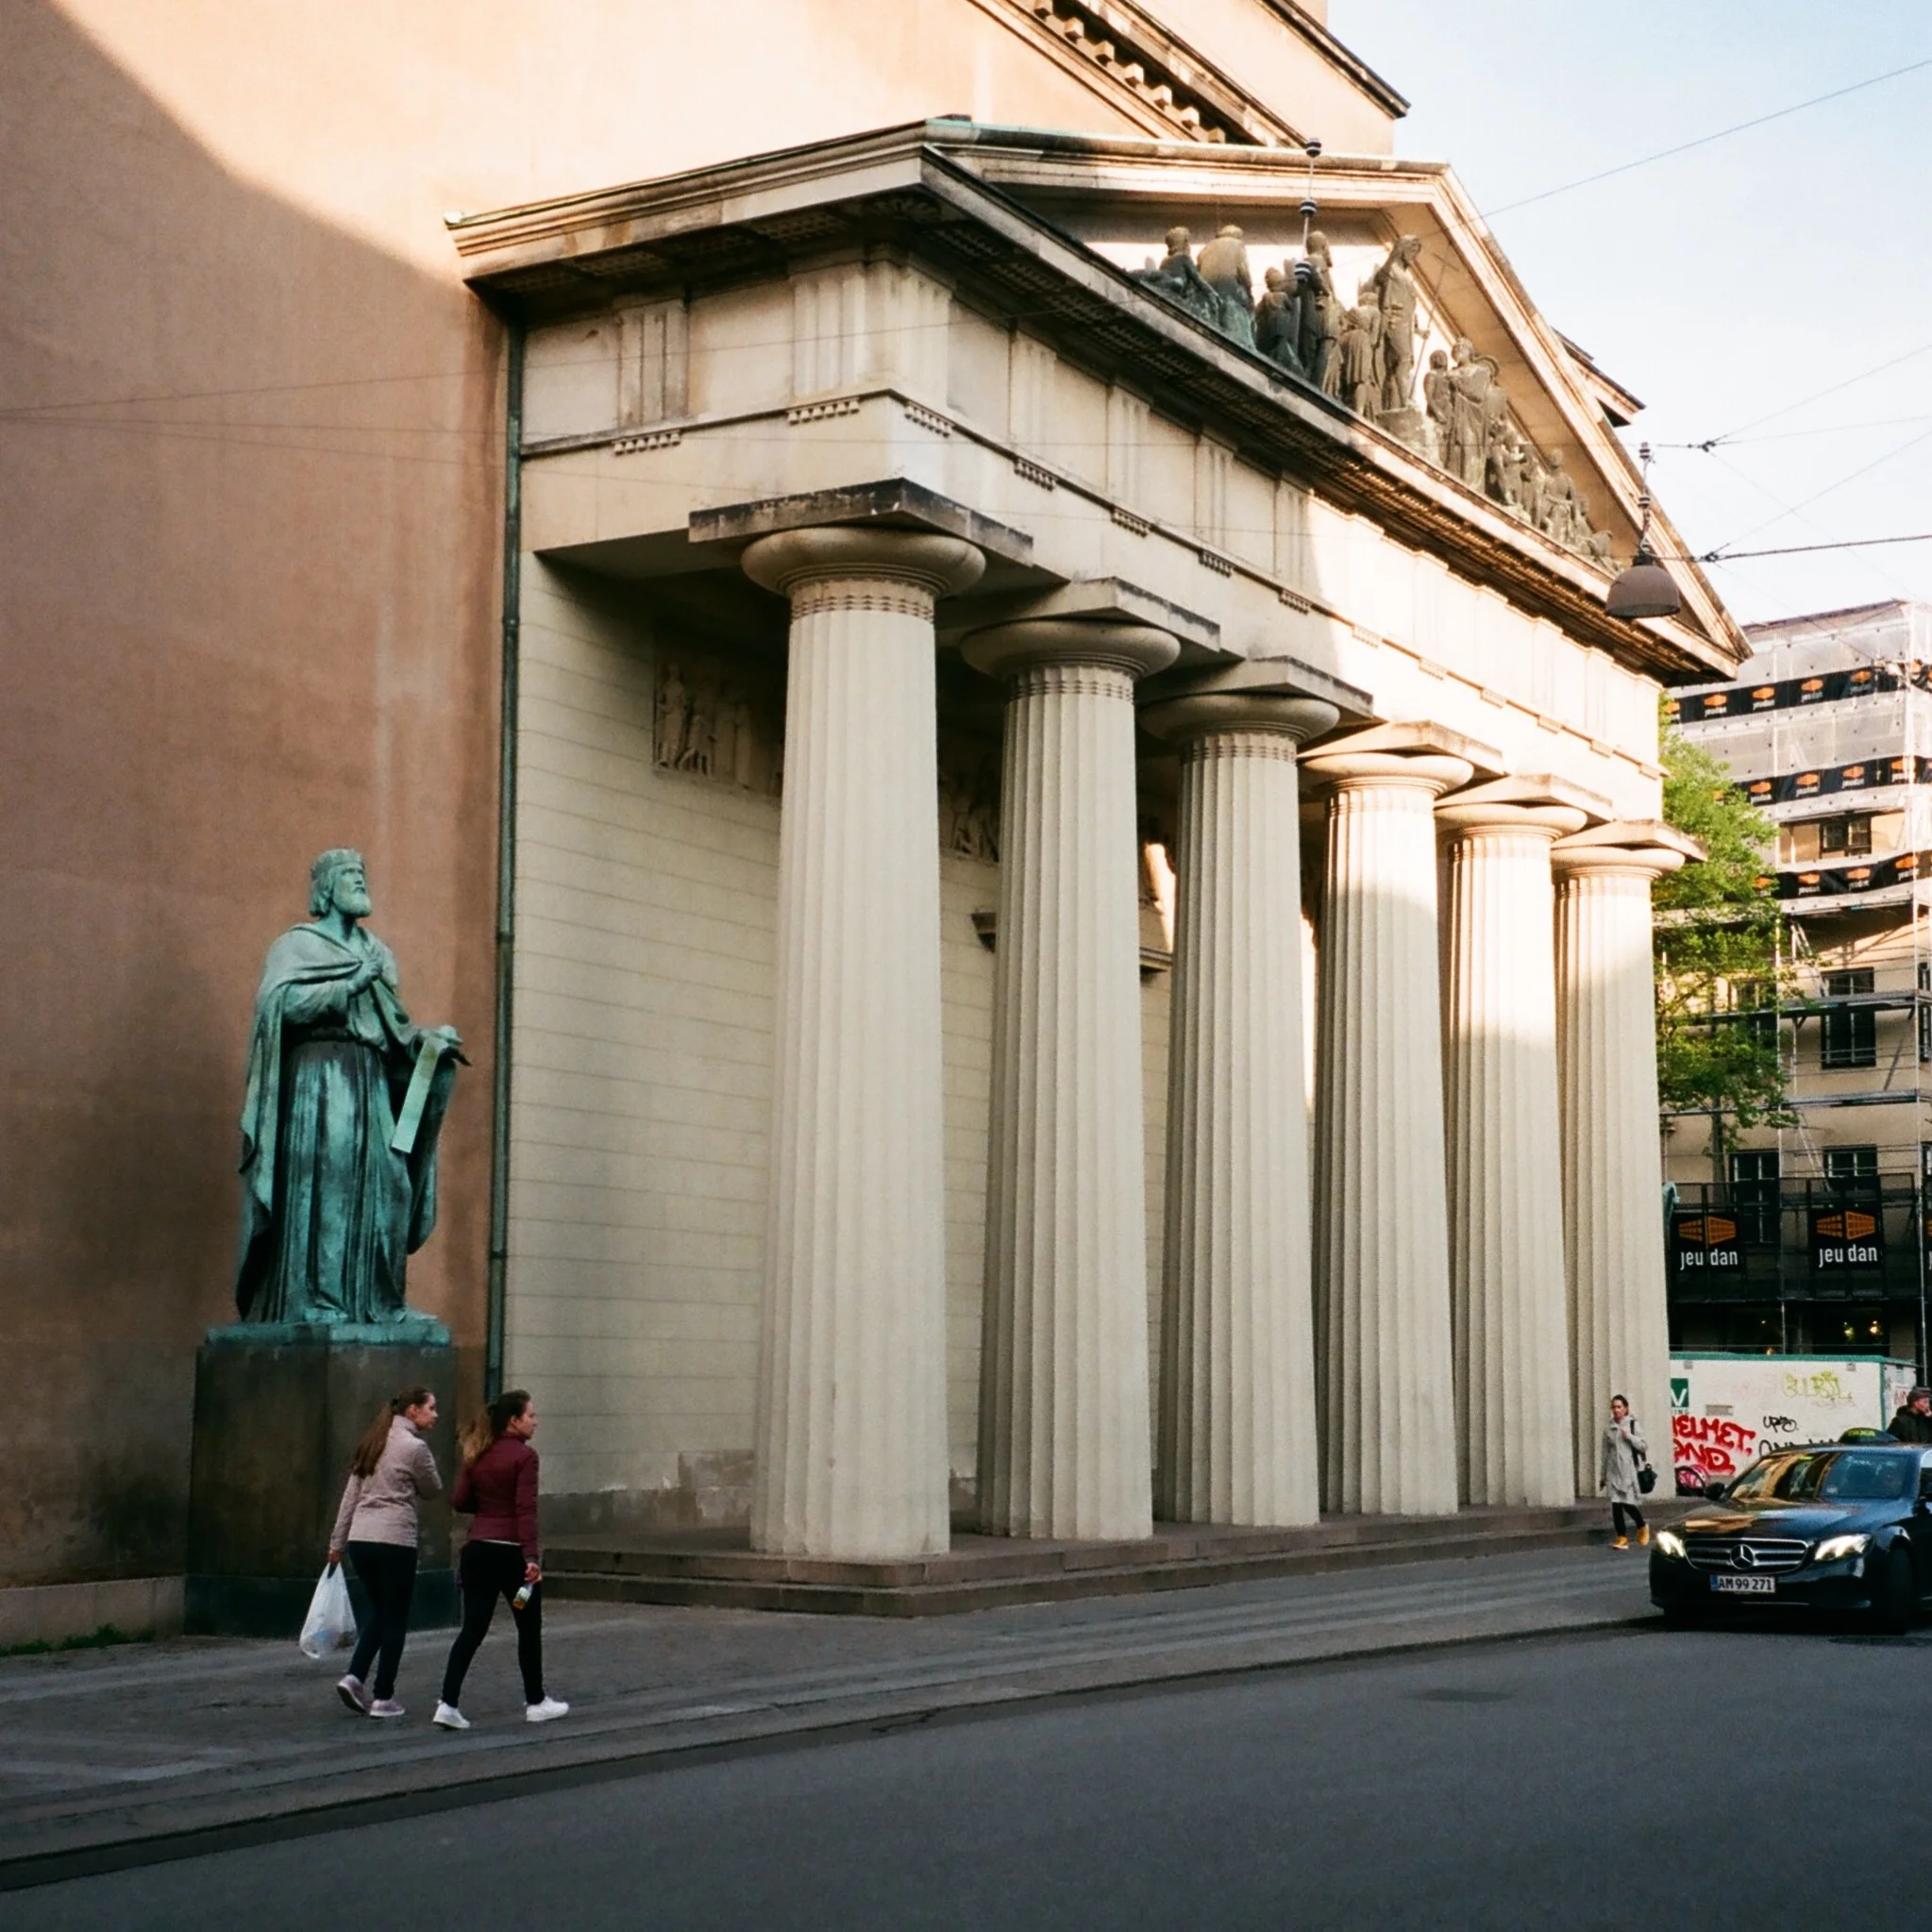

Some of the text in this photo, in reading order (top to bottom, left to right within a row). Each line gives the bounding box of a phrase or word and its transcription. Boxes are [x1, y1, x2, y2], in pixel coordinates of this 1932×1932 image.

[1680, 1248, 1738, 1270] jeu dan
[1819, 1244, 1877, 1268] jeu dan
[1719, 1577, 1772, 1590] AM 99 271
